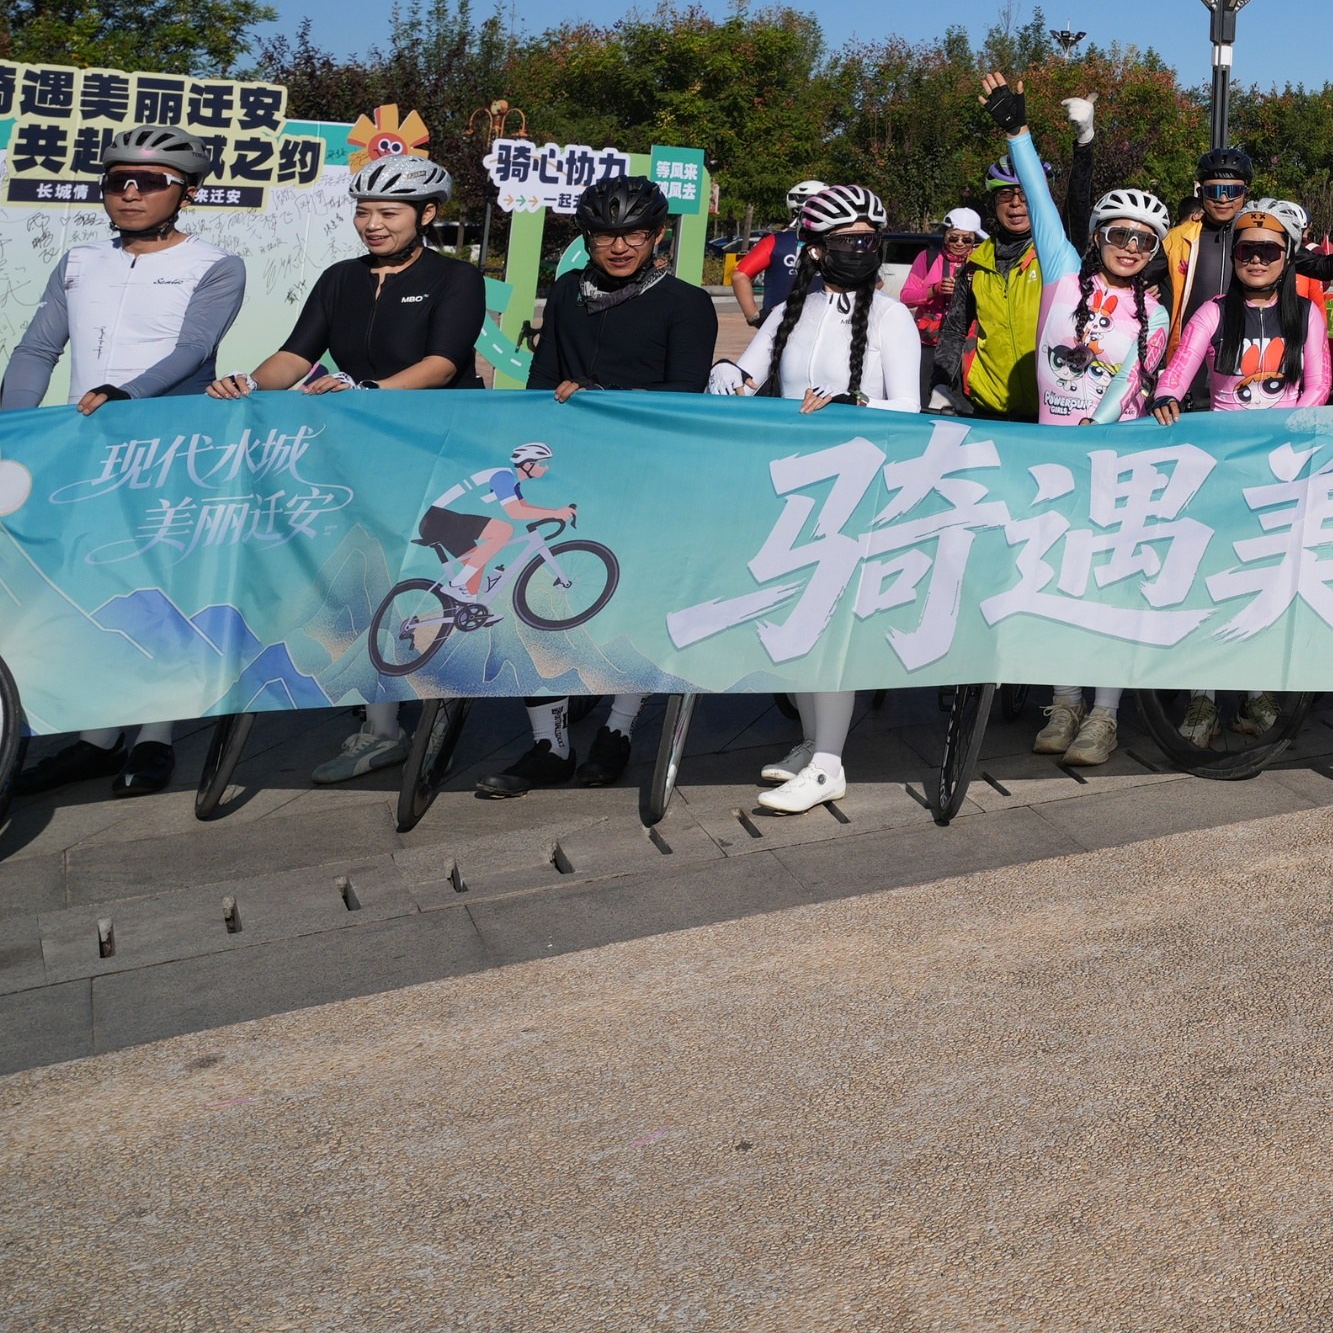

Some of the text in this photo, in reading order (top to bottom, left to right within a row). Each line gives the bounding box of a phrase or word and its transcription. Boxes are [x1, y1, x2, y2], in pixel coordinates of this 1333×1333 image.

[12, 124, 321, 183] 共赴之约
[495, 145, 627, 186] 骑心协力
[656, 160, 697, 180] 等风来
[36, 183, 89, 200] 长城情
[88, 424, 327, 491] 现代水城
[130, 487, 337, 555] 美丽迁安
